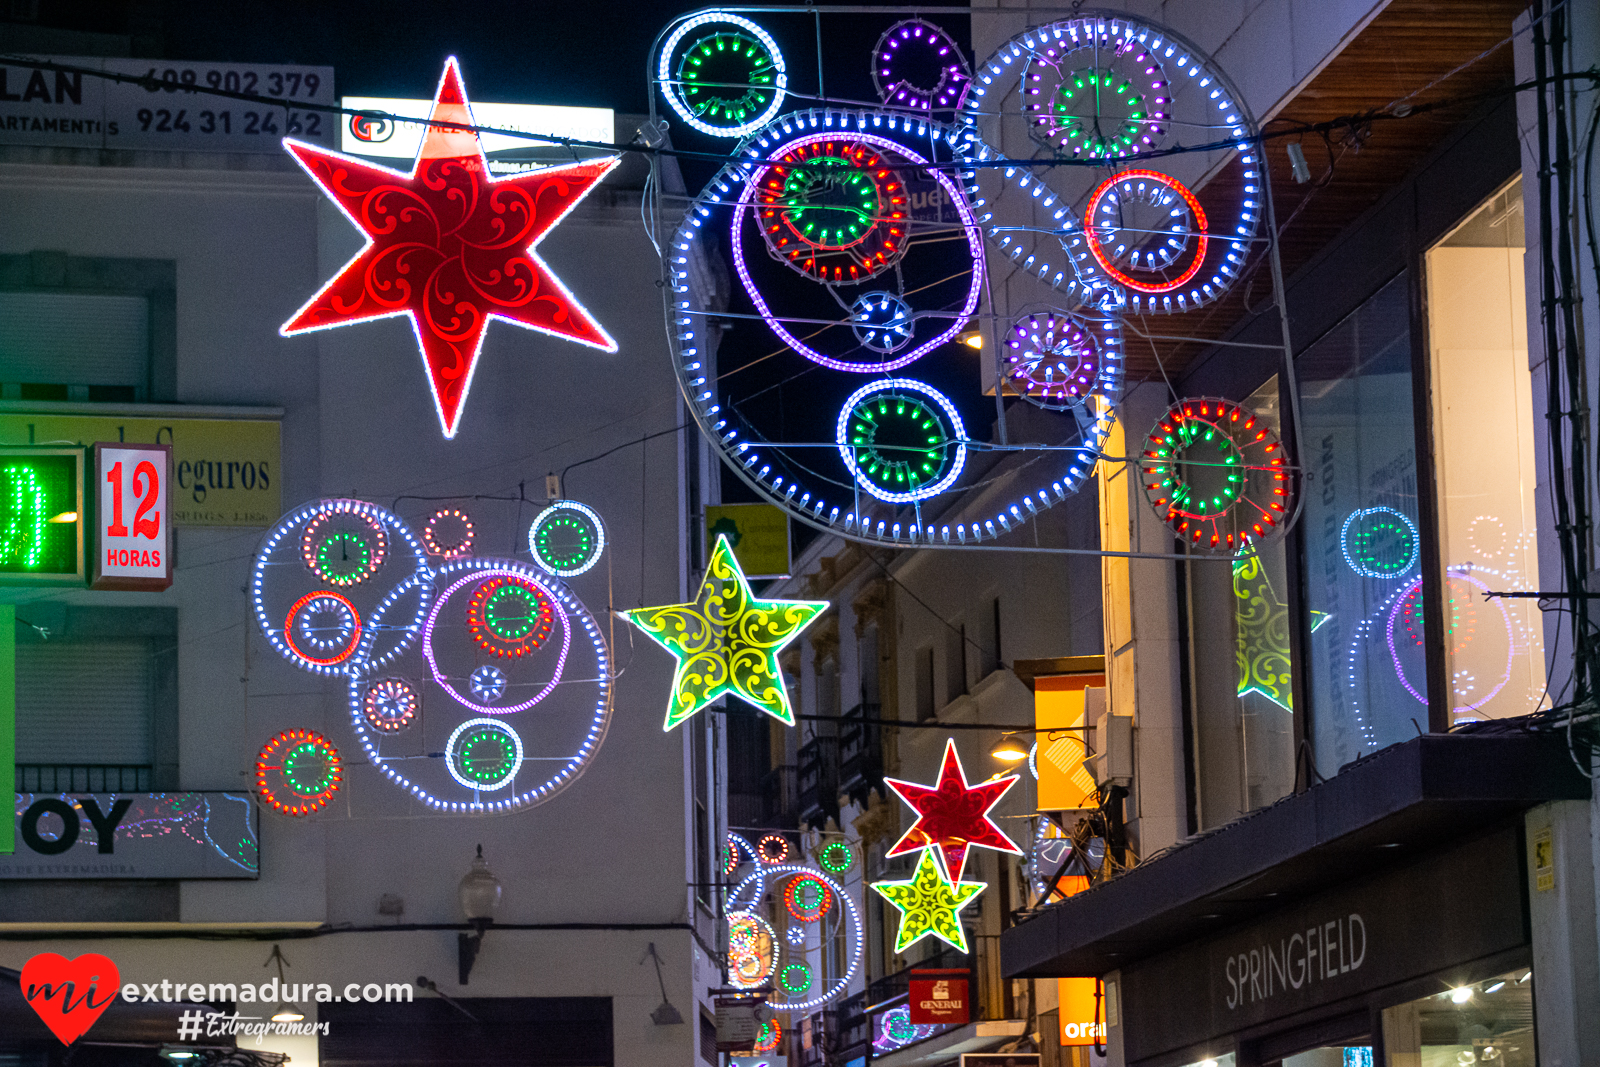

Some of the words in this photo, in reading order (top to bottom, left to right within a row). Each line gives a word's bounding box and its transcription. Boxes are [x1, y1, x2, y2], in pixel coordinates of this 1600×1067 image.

[143, 68, 197, 94] 609
[206, 69, 258, 96] 902
[268, 72, 320, 98] 379
[137, 108, 190, 133] 924
[199, 110, 230, 134] 31
[244, 111, 278, 135] 24
[288, 112, 321, 136] 62
[106, 460, 160, 540] 12
[107, 549, 161, 568] HORAS
[1226, 913, 1366, 1010] SPRINGFIELD
[920, 1000, 962, 1010] GENERALI
